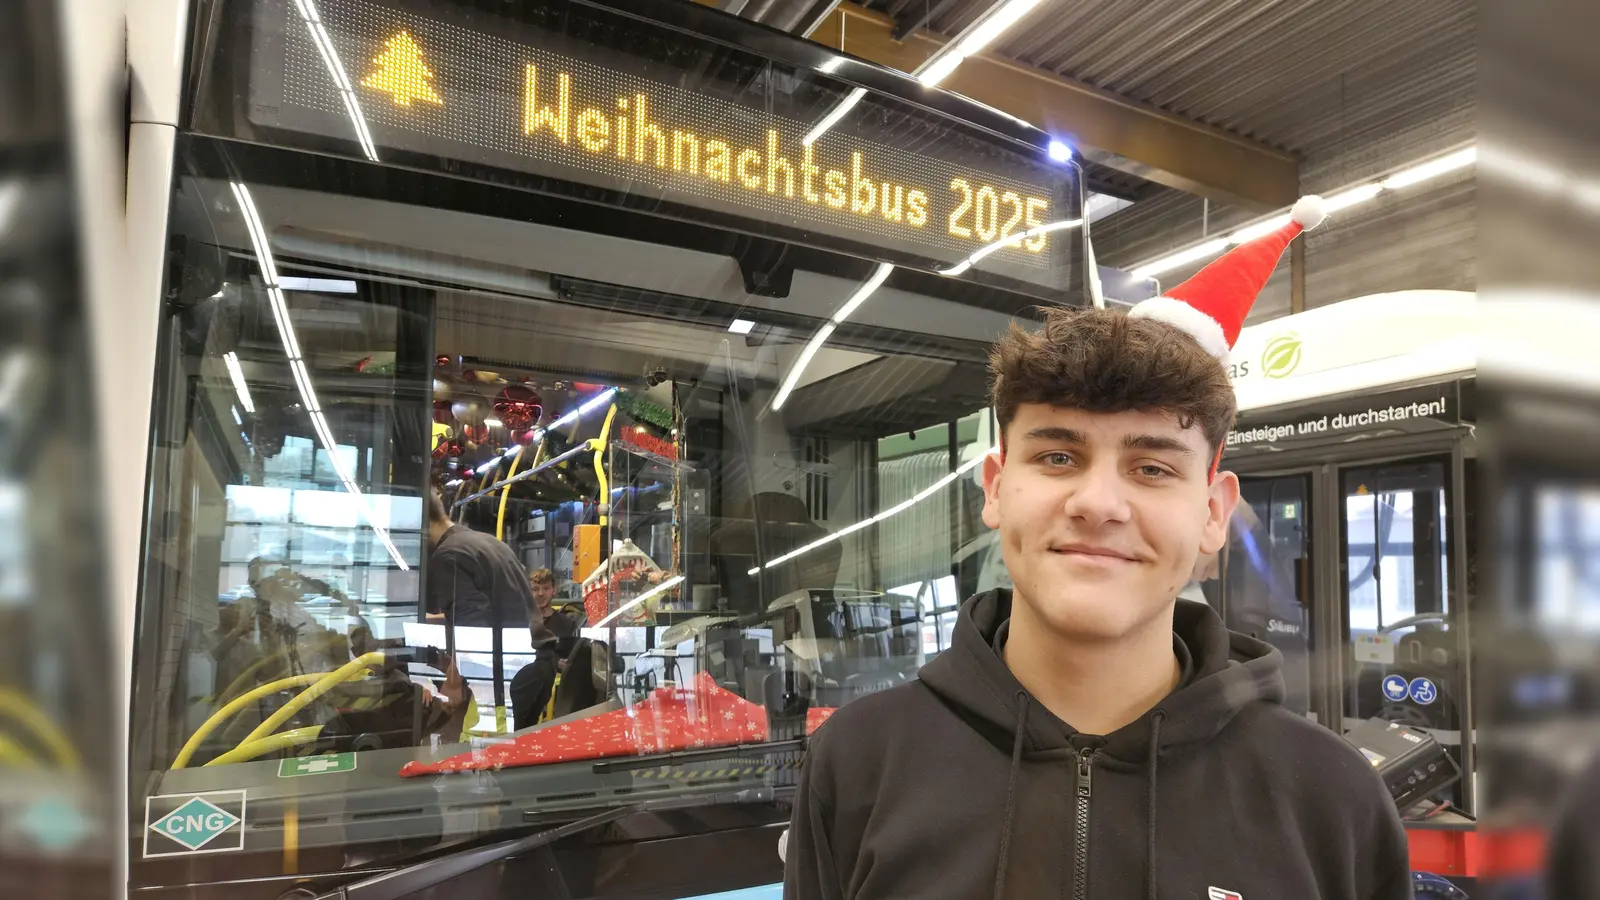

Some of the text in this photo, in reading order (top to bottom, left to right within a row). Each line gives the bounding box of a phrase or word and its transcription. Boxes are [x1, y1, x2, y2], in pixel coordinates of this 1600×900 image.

[521, 62, 1050, 253] Weihnachtsbus 2025
[1228, 361, 1249, 379] as
[1227, 397, 1446, 445] Einsteigen und durchstarten!
[166, 814, 224, 834] CNG
